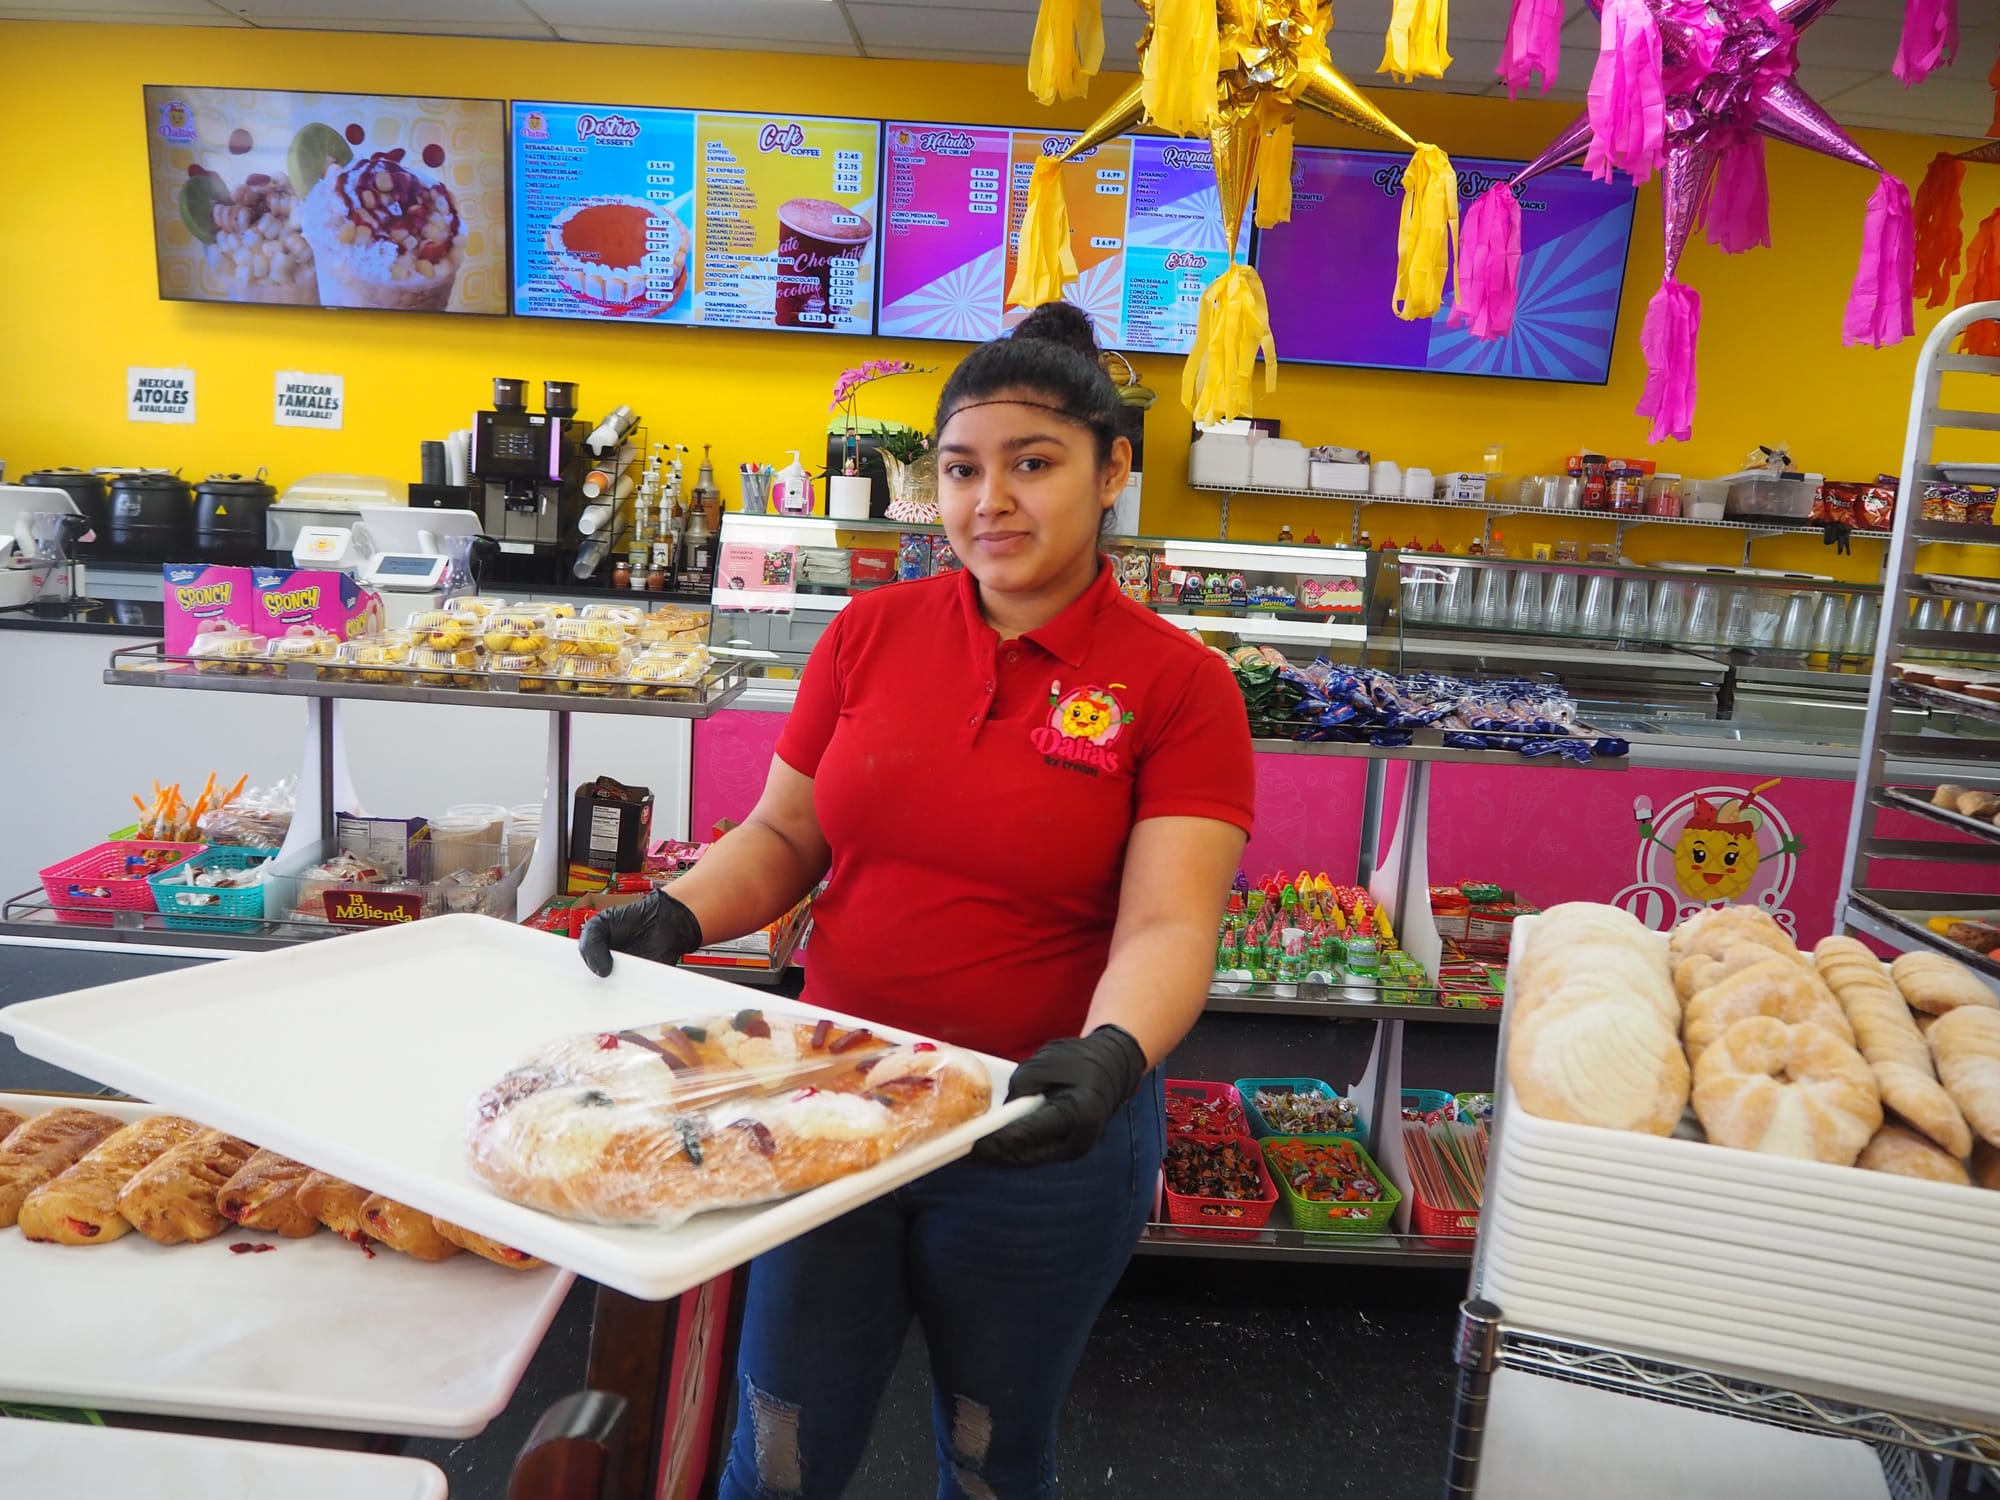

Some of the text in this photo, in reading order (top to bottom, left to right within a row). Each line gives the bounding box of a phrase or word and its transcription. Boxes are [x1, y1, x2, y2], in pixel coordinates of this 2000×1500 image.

[578, 115, 640, 141] Postres
[596, 138, 633, 146] DESSERTS
[760, 124, 804, 152] Café
[920, 132, 975, 150] Helados
[1165, 253, 1207, 270] Extras
[139, 378, 184, 389] MEXICAN
[286, 384, 331, 395] MEXICAN
[133, 389, 188, 405] ATOLES
[277, 394, 339, 410] TAMALES
[138, 404, 184, 414] AVAILABLE!
[176, 582, 232, 611] SPONCH
[263, 586, 320, 617] SPONCH
[349, 894, 363, 905] La
[336, 904, 413, 922] Molienda
